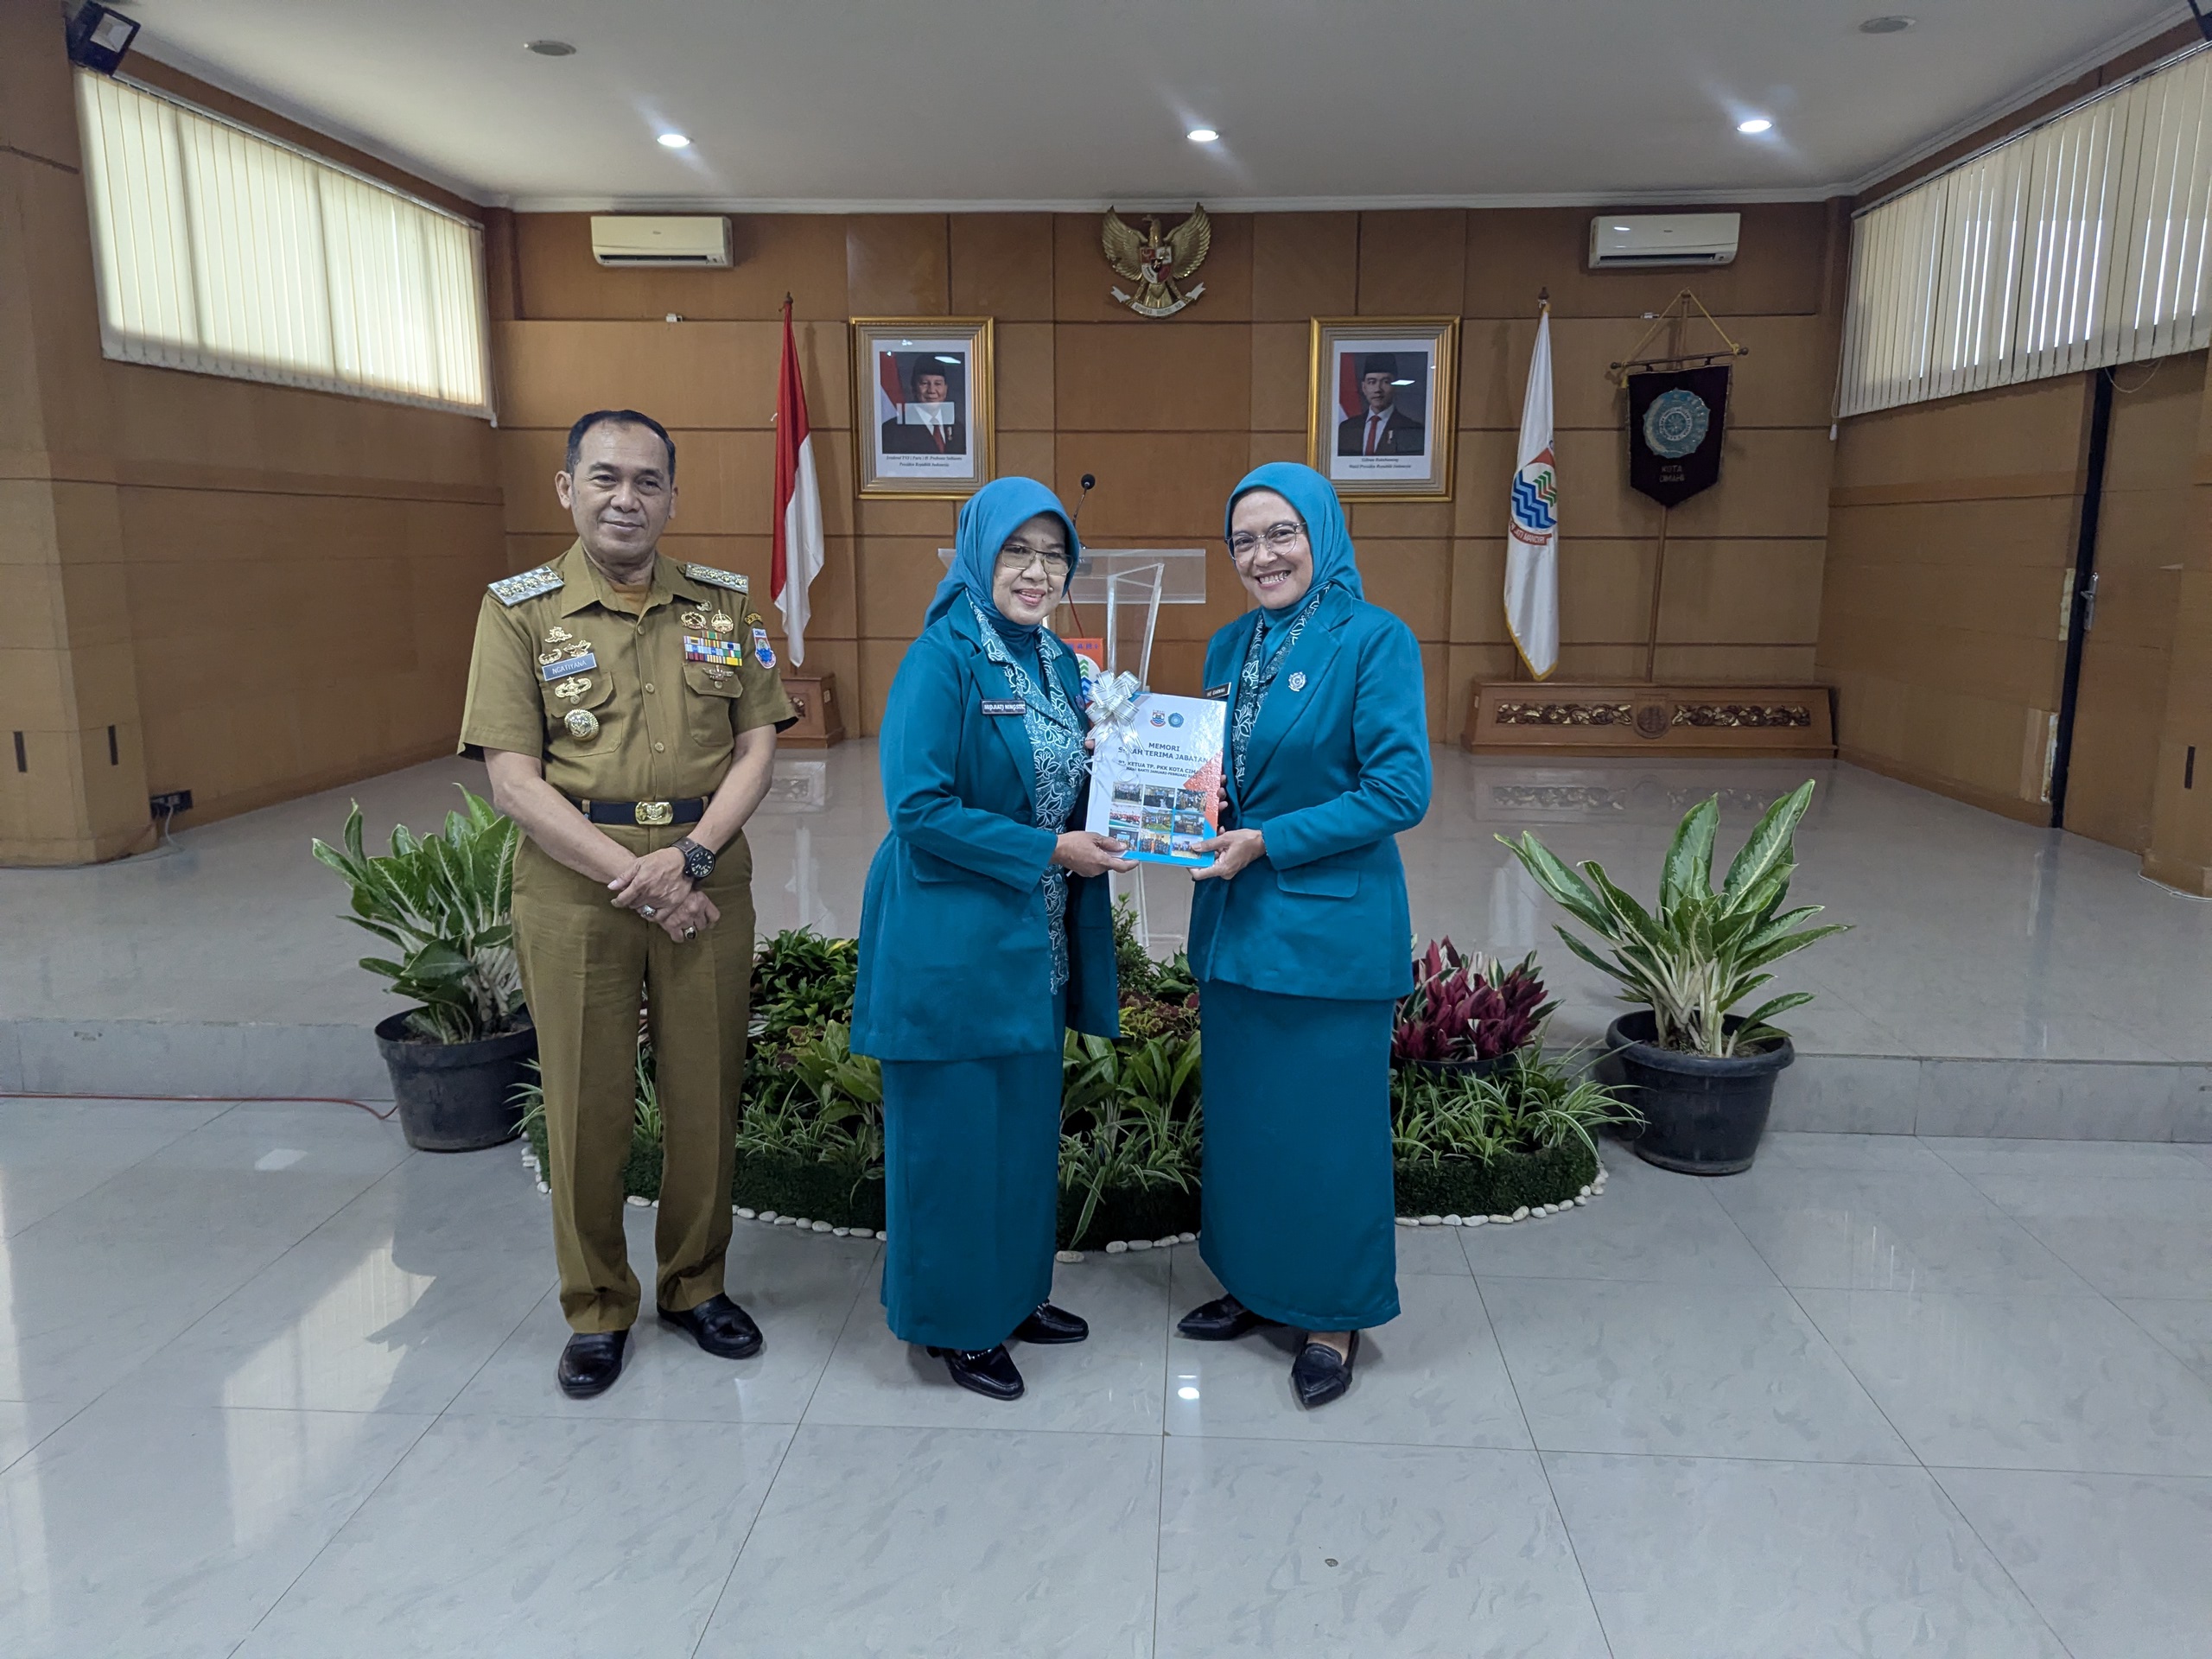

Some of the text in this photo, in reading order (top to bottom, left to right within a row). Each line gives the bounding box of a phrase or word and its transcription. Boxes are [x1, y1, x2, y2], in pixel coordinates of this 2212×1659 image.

[552, 660, 587, 674] NGATIYANA
[1148, 742, 1180, 752] MEMORI
[1118, 747, 1209, 764] SAH TERIMA JABATAN
